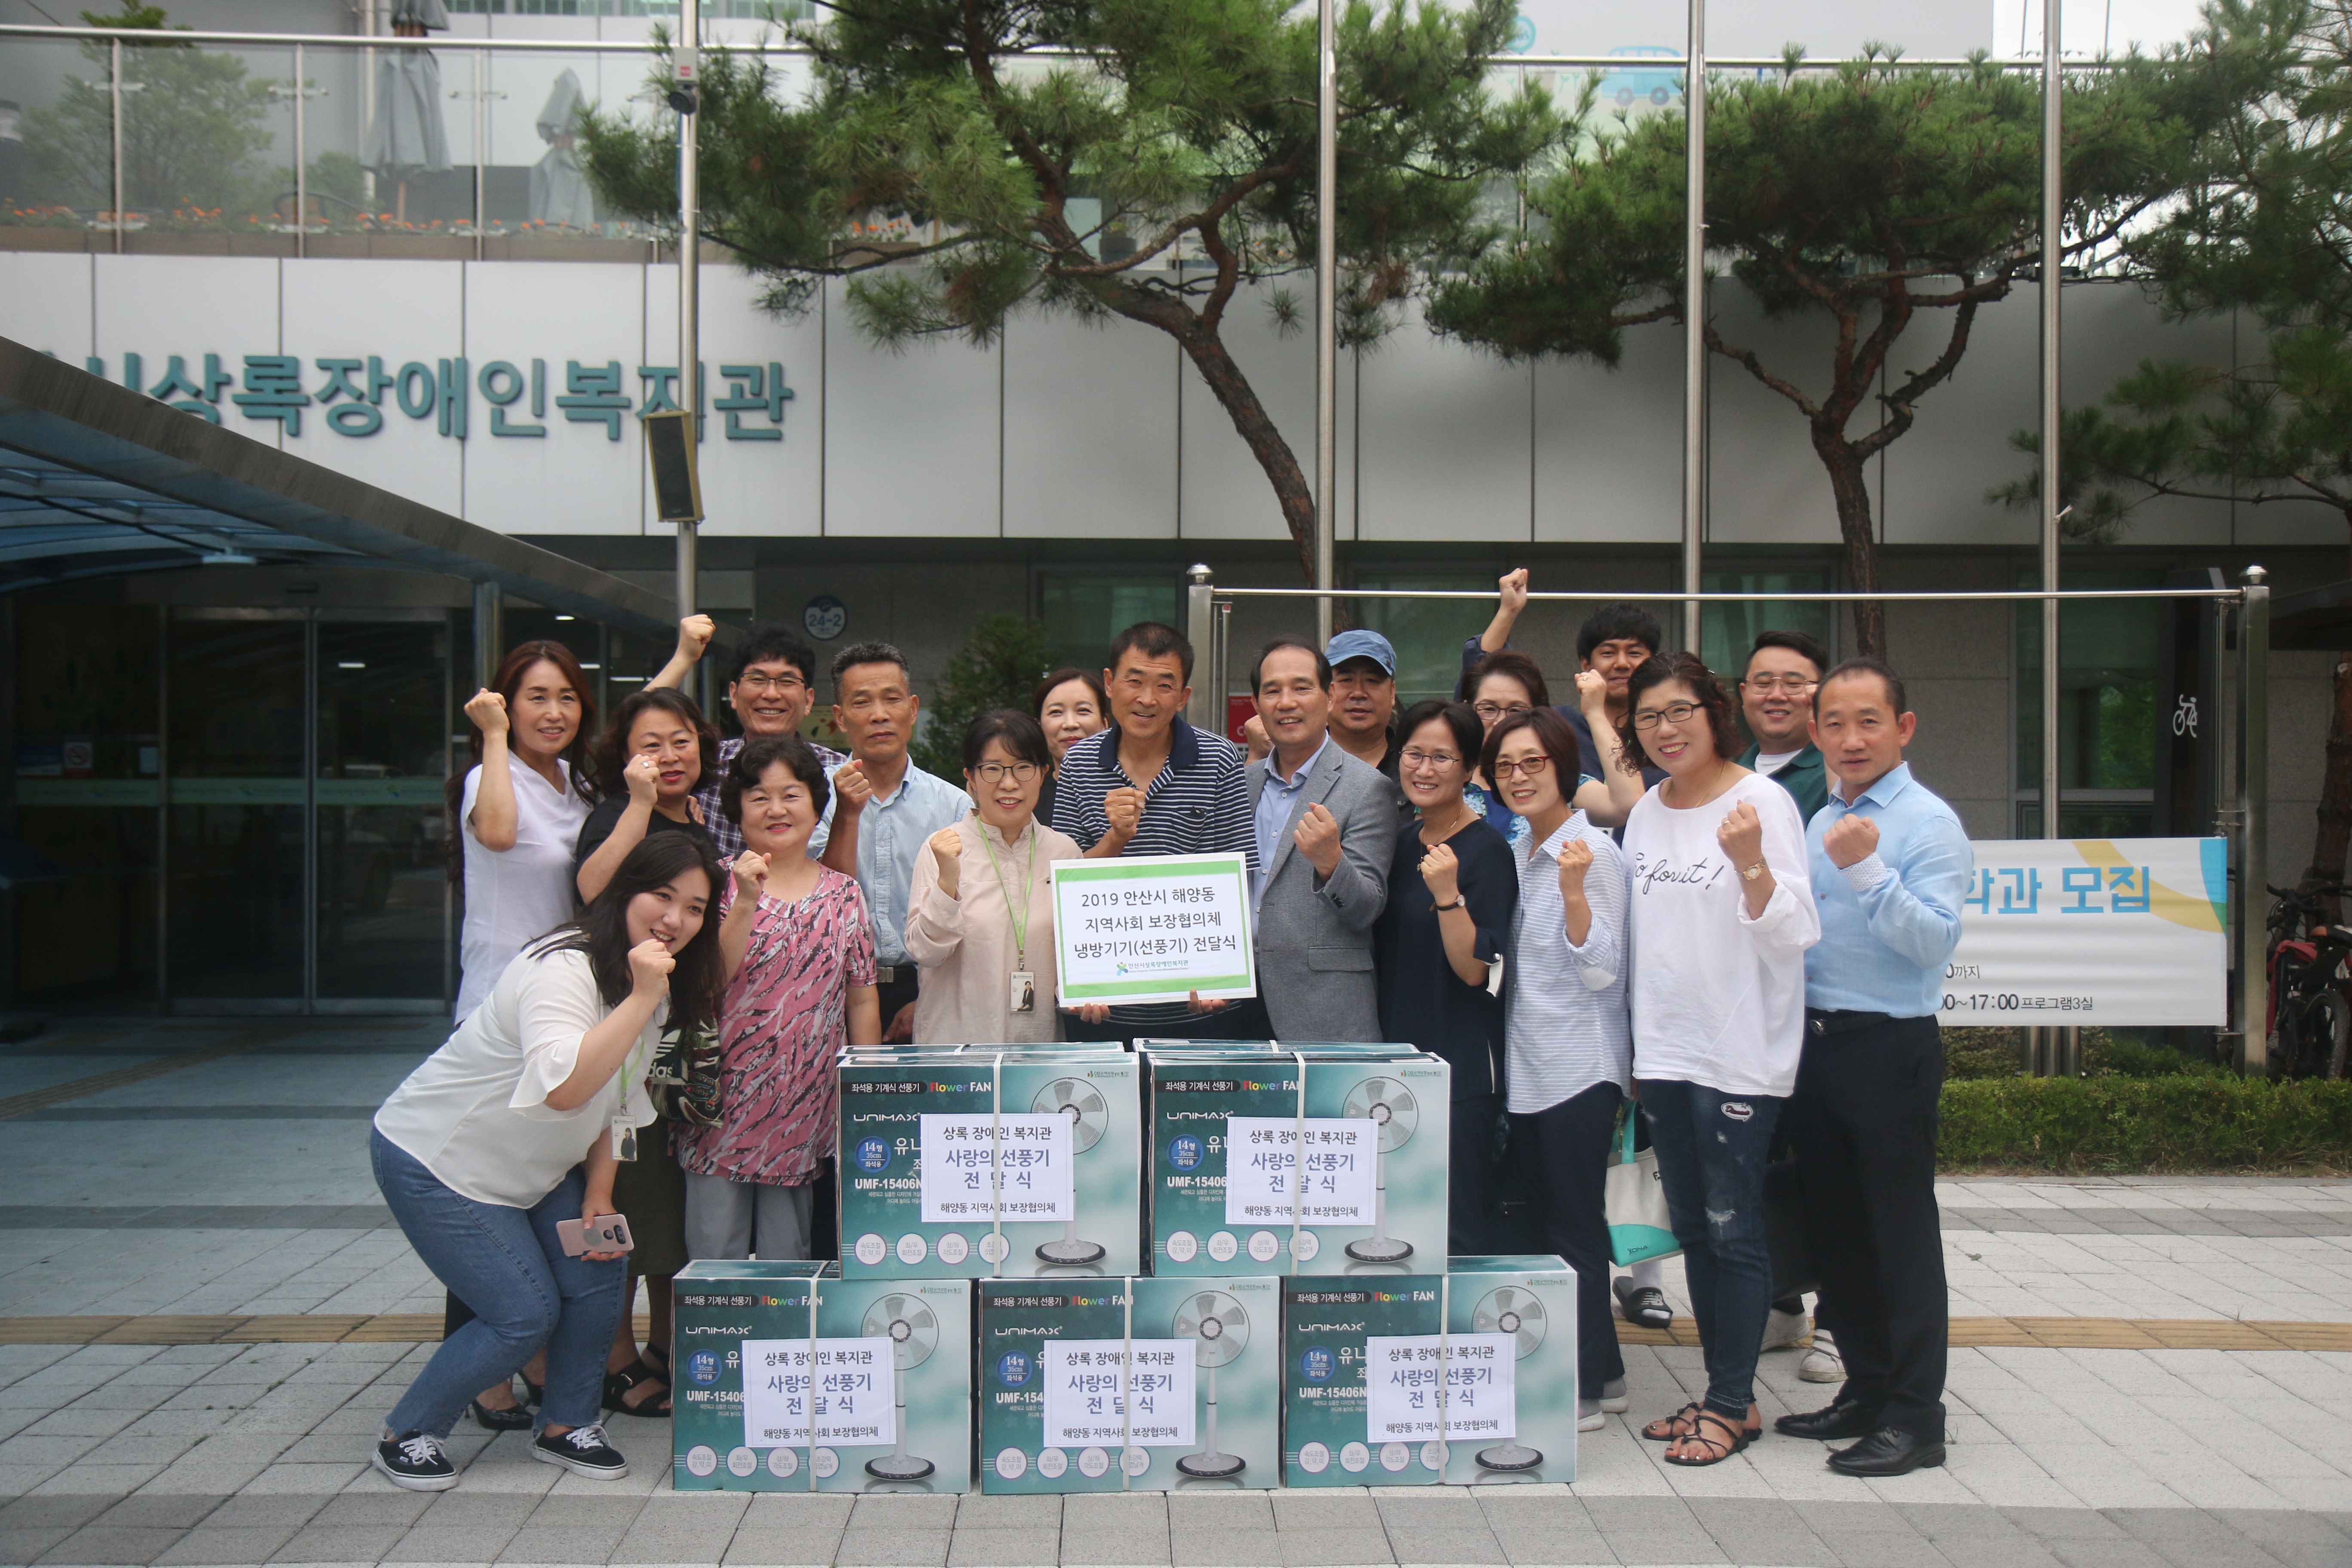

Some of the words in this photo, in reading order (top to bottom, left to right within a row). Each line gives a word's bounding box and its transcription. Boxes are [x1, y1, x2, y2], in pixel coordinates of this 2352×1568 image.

[86, 352, 793, 441] 상록장애인복지관
[809, 614, 842, 627] 24-2
[1081, 892, 1118, 907] 2019
[1124, 889, 1167, 906] 안산시
[1172, 886, 1216, 903] 해양동
[2061, 866, 2150, 913] 모집
[1085, 915, 1143, 933] 지역사회
[1148, 911, 1222, 928] 보장협의체
[1075, 937, 1188, 959] 냉방기기(선풍기)
[1193, 934, 1236, 952] 전달식
[1128, 960, 1188, 969] 안산시상록장애인복지관
[1945, 963, 1980, 979] 0까지
[1942, 994, 2019, 1010] 0~17:00
[2021, 996, 2093, 1010] 프로그램3실
[851, 1083, 873, 1092] 좌석용
[875, 1083, 896, 1092] 기계식
[898, 1083, 920, 1092] 선풍기
[930, 1082, 968, 1092] Flower
[970, 1081, 992, 1092] FAN
[1165, 1081, 1187, 1091] 좌석용
[1189, 1081, 1210, 1091] 기계식
[1212, 1081, 1233, 1090] 선풍기
[1243, 1080, 1280, 1090] Flower
[1283, 1080, 1298, 1090] FA
[854, 1113, 918, 1121] UNIMAX
[943, 1126, 969, 1140] 상록
[1014, 1126, 1052, 1140] 복지관
[1250, 1130, 1274, 1144] 상록
[1319, 1131, 1357, 1145] 복지관
[945, 1148, 994, 1167] 사랑의
[1000, 1148, 1050, 1167] 선풍기
[1305, 1153, 1354, 1172] 선풍기
[964, 1171, 980, 1189] 전
[1016, 1171, 1031, 1189] 식
[1269, 1175, 1284, 1193] 전
[1320, 1175, 1335, 1194] 식
[940, 1202, 969, 1213] 해양동
[1009, 1202, 1056, 1213] 보장협의체
[1244, 1205, 1273, 1216] 해양동
[1312, 1206, 1359, 1217] 보장협의체
[684, 1296, 705, 1305] 좌석용
[707, 1296, 729, 1305] 기계식
[731, 1296, 752, 1305] 선풍기
[761, 1295, 799, 1305] Flower
[993, 1297, 1015, 1306] 좌석용
[1017, 1297, 1038, 1306] 기계식
[1040, 1296, 1062, 1306] 선풍기
[1072, 1295, 1109, 1305] Flower
[1297, 1293, 1318, 1302] 좌석용
[1320, 1293, 1341, 1302] 기계식
[1343, 1292, 1364, 1302] 선풍기
[1374, 1291, 1411, 1301] Flower
[1413, 1290, 1434, 1301] FAN
[686, 1326, 749, 1334] UNIMAX
[995, 1327, 1060, 1335] UNIMAX
[765, 1352, 790, 1366] 상록
[835, 1351, 873, 1365] 복지관
[1066, 1352, 1091, 1366] 상록
[1136, 1351, 1175, 1365] 복지관
[1389, 1348, 1413, 1362] 상록
[1457, 1345, 1494, 1359] 복지관
[822, 1373, 871, 1392] 선풍기
[1068, 1374, 1117, 1393] 사랑의
[1390, 1368, 1438, 1387] 사랑의
[1445, 1367, 1491, 1385] 선풍기
[786, 1396, 802, 1415] 전
[815, 1396, 829, 1415] 달
[838, 1396, 853, 1414] 식
[1087, 1396, 1102, 1415] 전
[1139, 1396, 1154, 1414] 식
[1409, 1390, 1424, 1409] 전
[1459, 1389, 1474, 1407] 식
[763, 1428, 791, 1439] 해양동
[832, 1426, 879, 1437] 보장협의체
[1063, 1427, 1091, 1438] 해양동
[1131, 1426, 1178, 1437] 보장협의체
[1386, 1423, 1413, 1433] 해양동
[1453, 1419, 1498, 1431] 보장협의체
